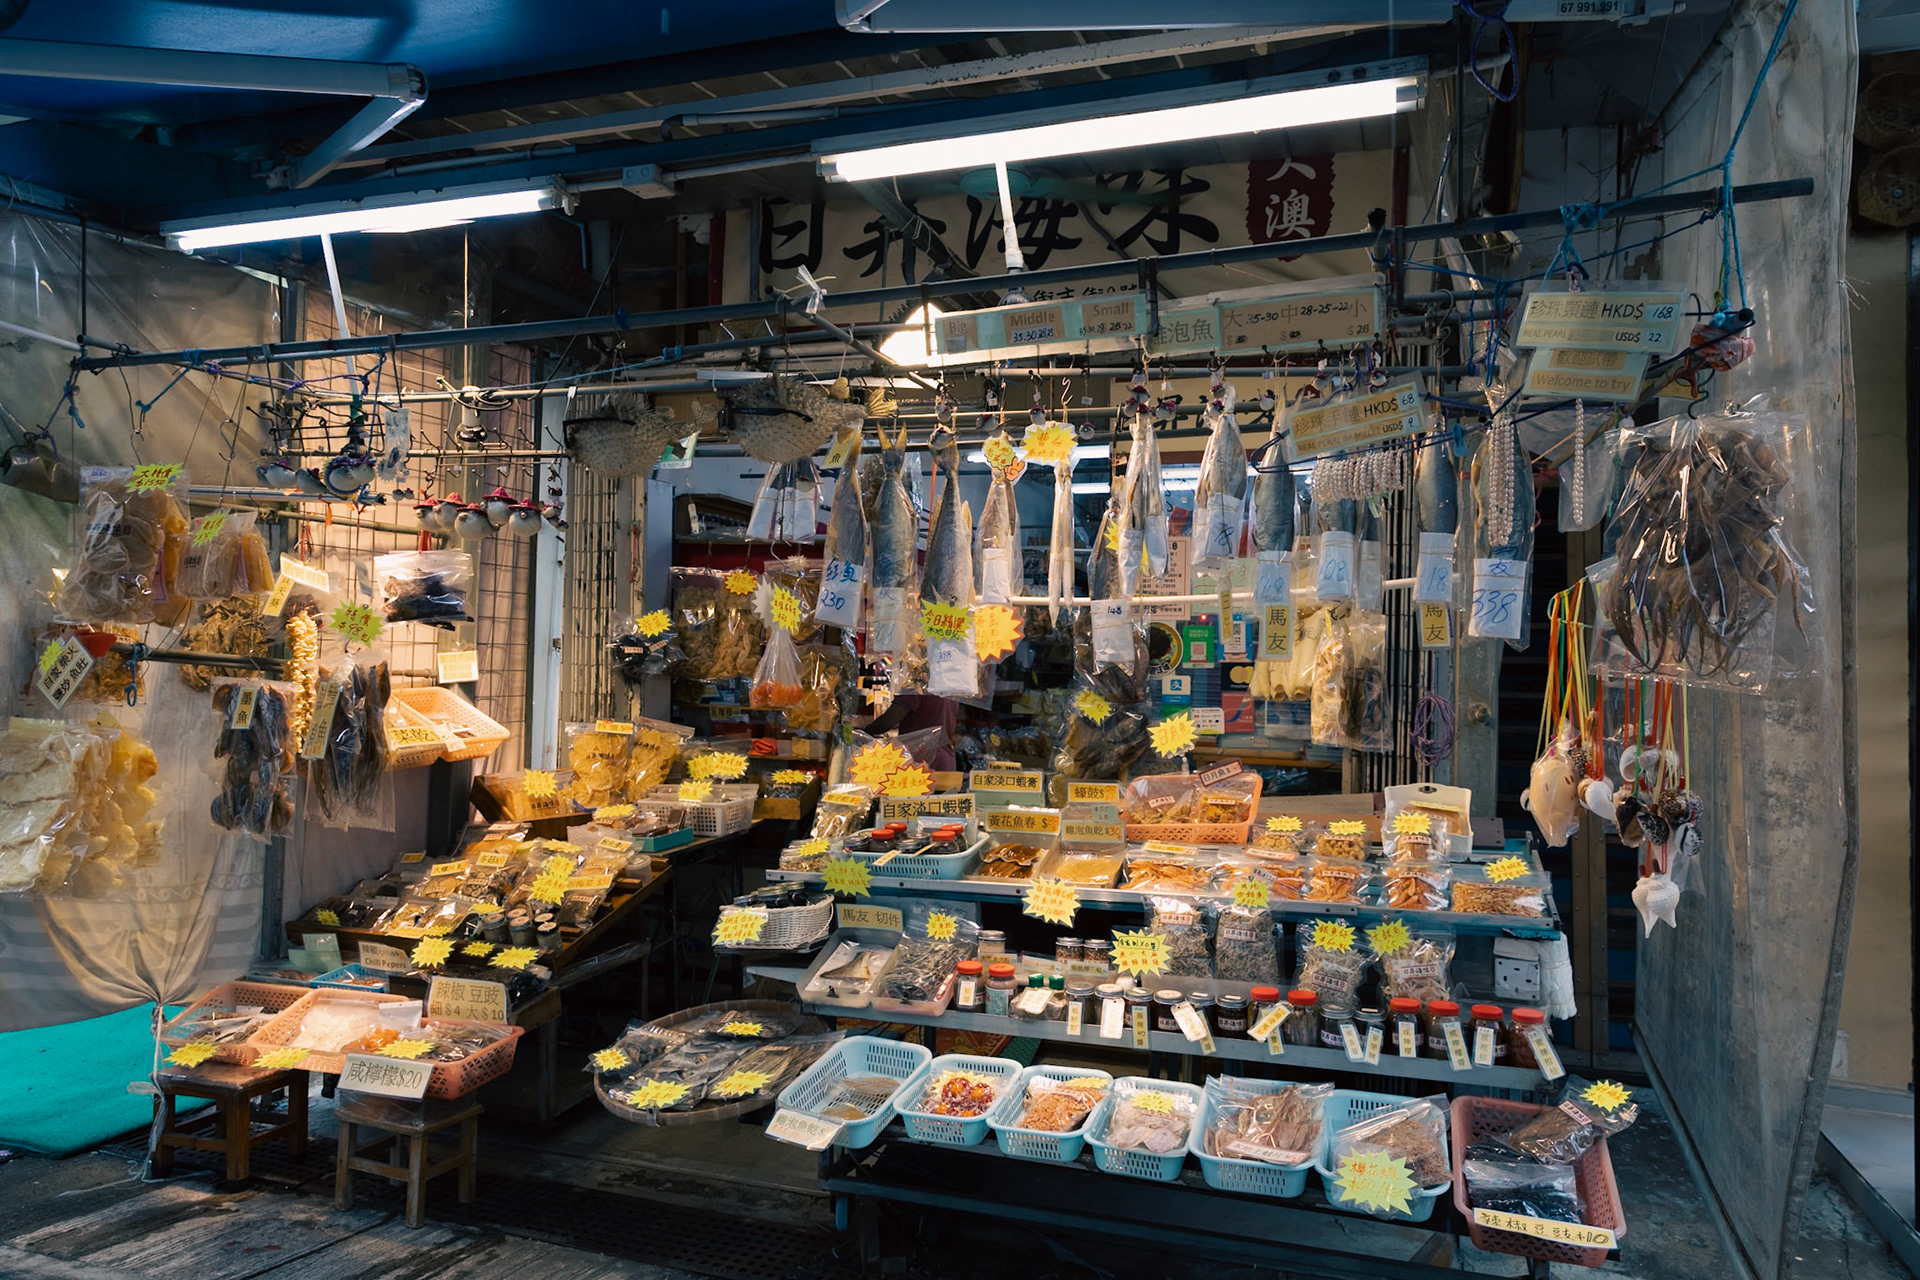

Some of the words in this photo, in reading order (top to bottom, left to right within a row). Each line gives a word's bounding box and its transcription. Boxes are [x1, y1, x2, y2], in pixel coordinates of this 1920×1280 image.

[1561, 3, 1573, 12] 67
[1577, 2, 1595, 12] 991
[1010, 309, 1055, 328] Middle
[1092, 302, 1129, 317] Small
[1223, 310, 1242, 329] 大
[1281, 303, 1298, 325] 中
[1350, 298, 1367, 318] 小
[1601, 303, 1644, 320] HKD$
[950, 321, 967, 334] Big
[1523, 329, 1541, 337] REAL
[1544, 330, 1567, 338] PEARL
[1615, 332, 1640, 343] USD$
[1536, 373, 1592, 388] Welcome
[1595, 377, 1608, 389] to
[1612, 378, 1630, 392] try
[1363, 398, 1399, 418] HKD$
[1382, 423, 1404, 434] USD$
[820, 589, 846, 611] 230
[1268, 608, 1287, 651] 馬友
[1424, 604, 1445, 641] 馬友
[842, 908, 869, 923] 馬友
[875, 911, 900, 927] 切件
[365, 957, 381, 968] Chilli
[382, 959, 407, 970] Pepers
[436, 981, 465, 1001] 辣椒
[469, 984, 500, 1006] 豆豉
